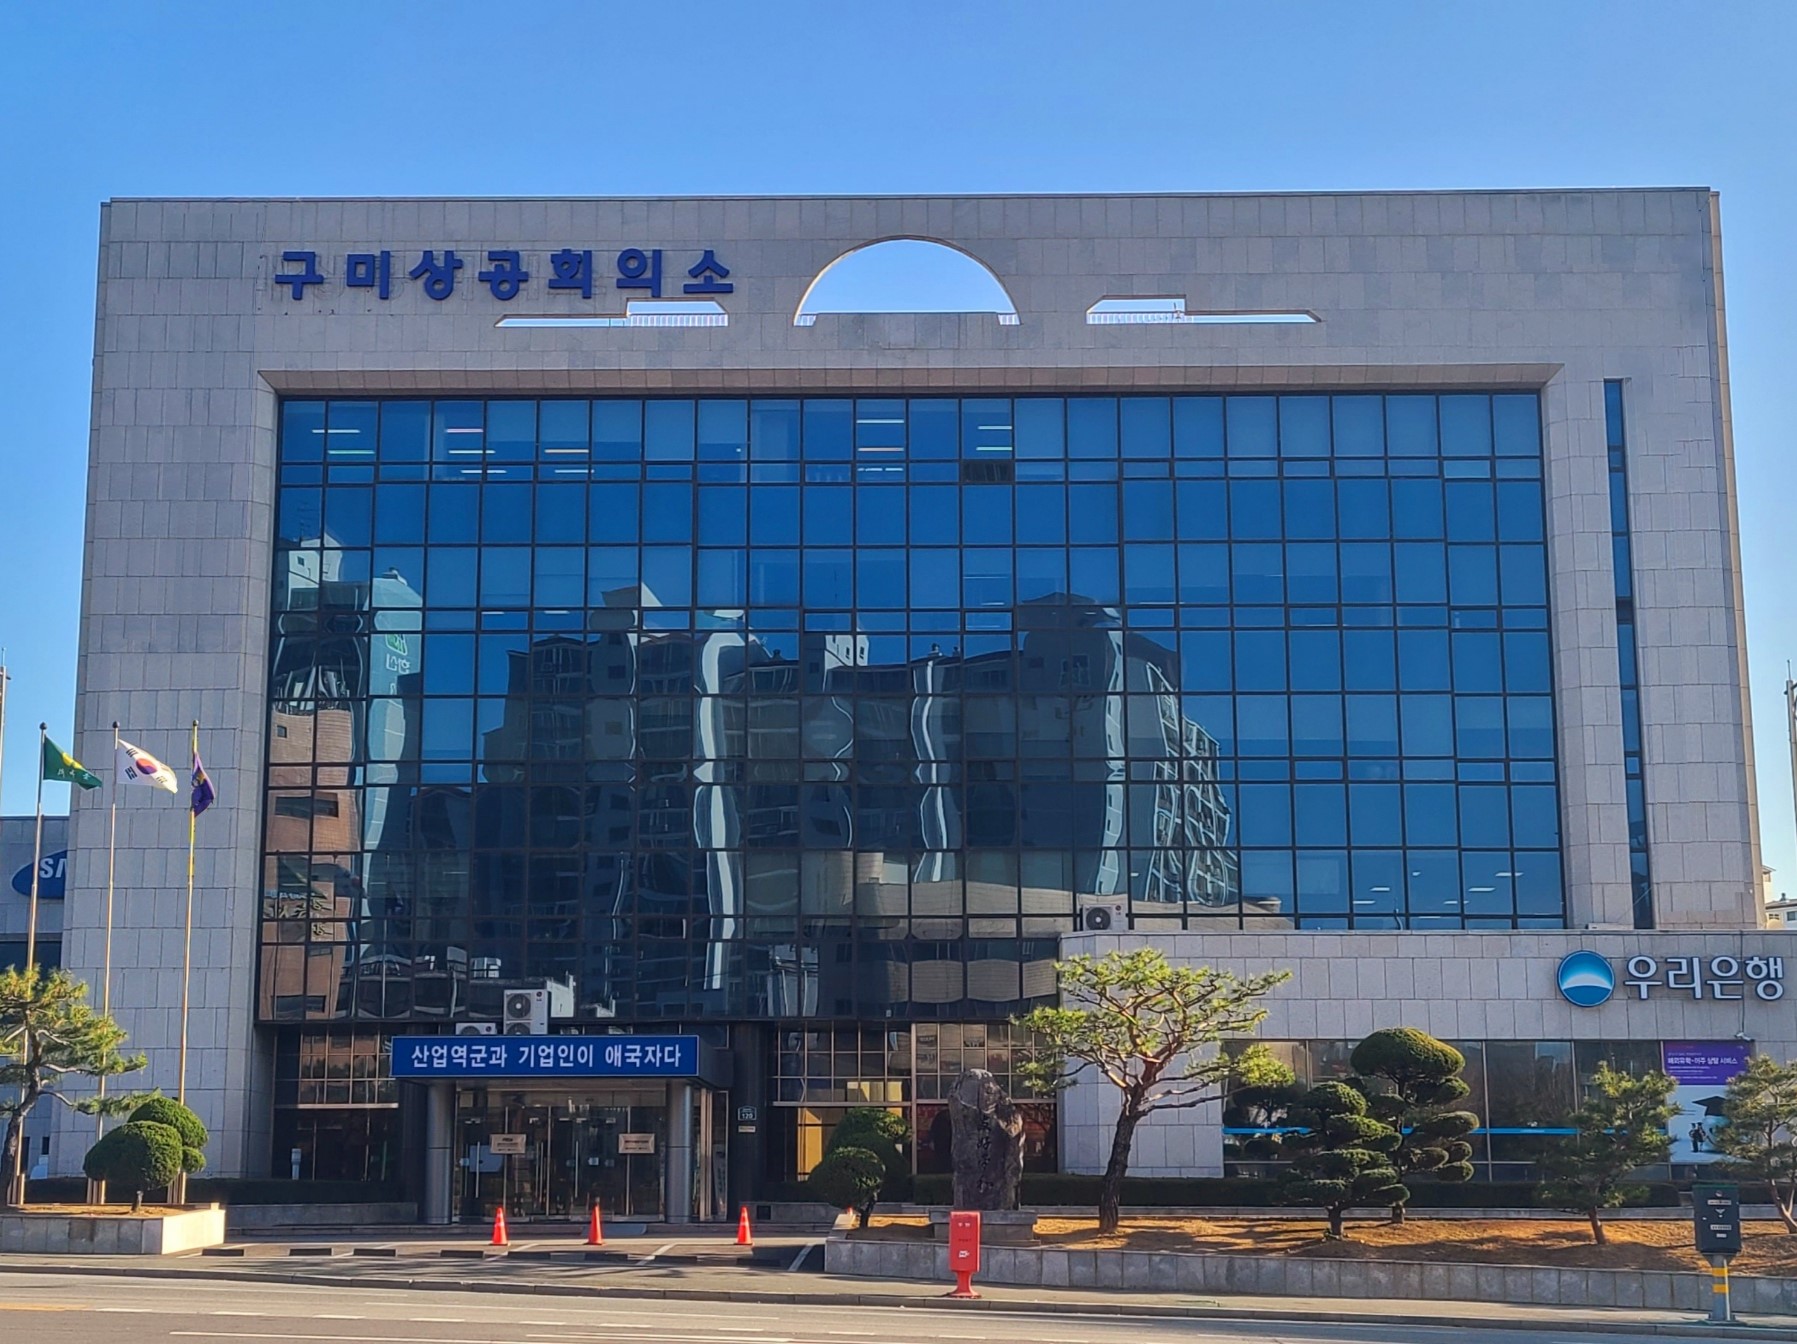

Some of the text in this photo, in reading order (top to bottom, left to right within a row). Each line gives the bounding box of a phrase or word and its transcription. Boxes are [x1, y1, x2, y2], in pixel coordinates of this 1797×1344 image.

[274, 247, 734, 300] 구미상공회의소
[1624, 955, 1785, 1001] 우리은행
[411, 1044, 682, 1068] 산업역군과 기업인이 애국자다
